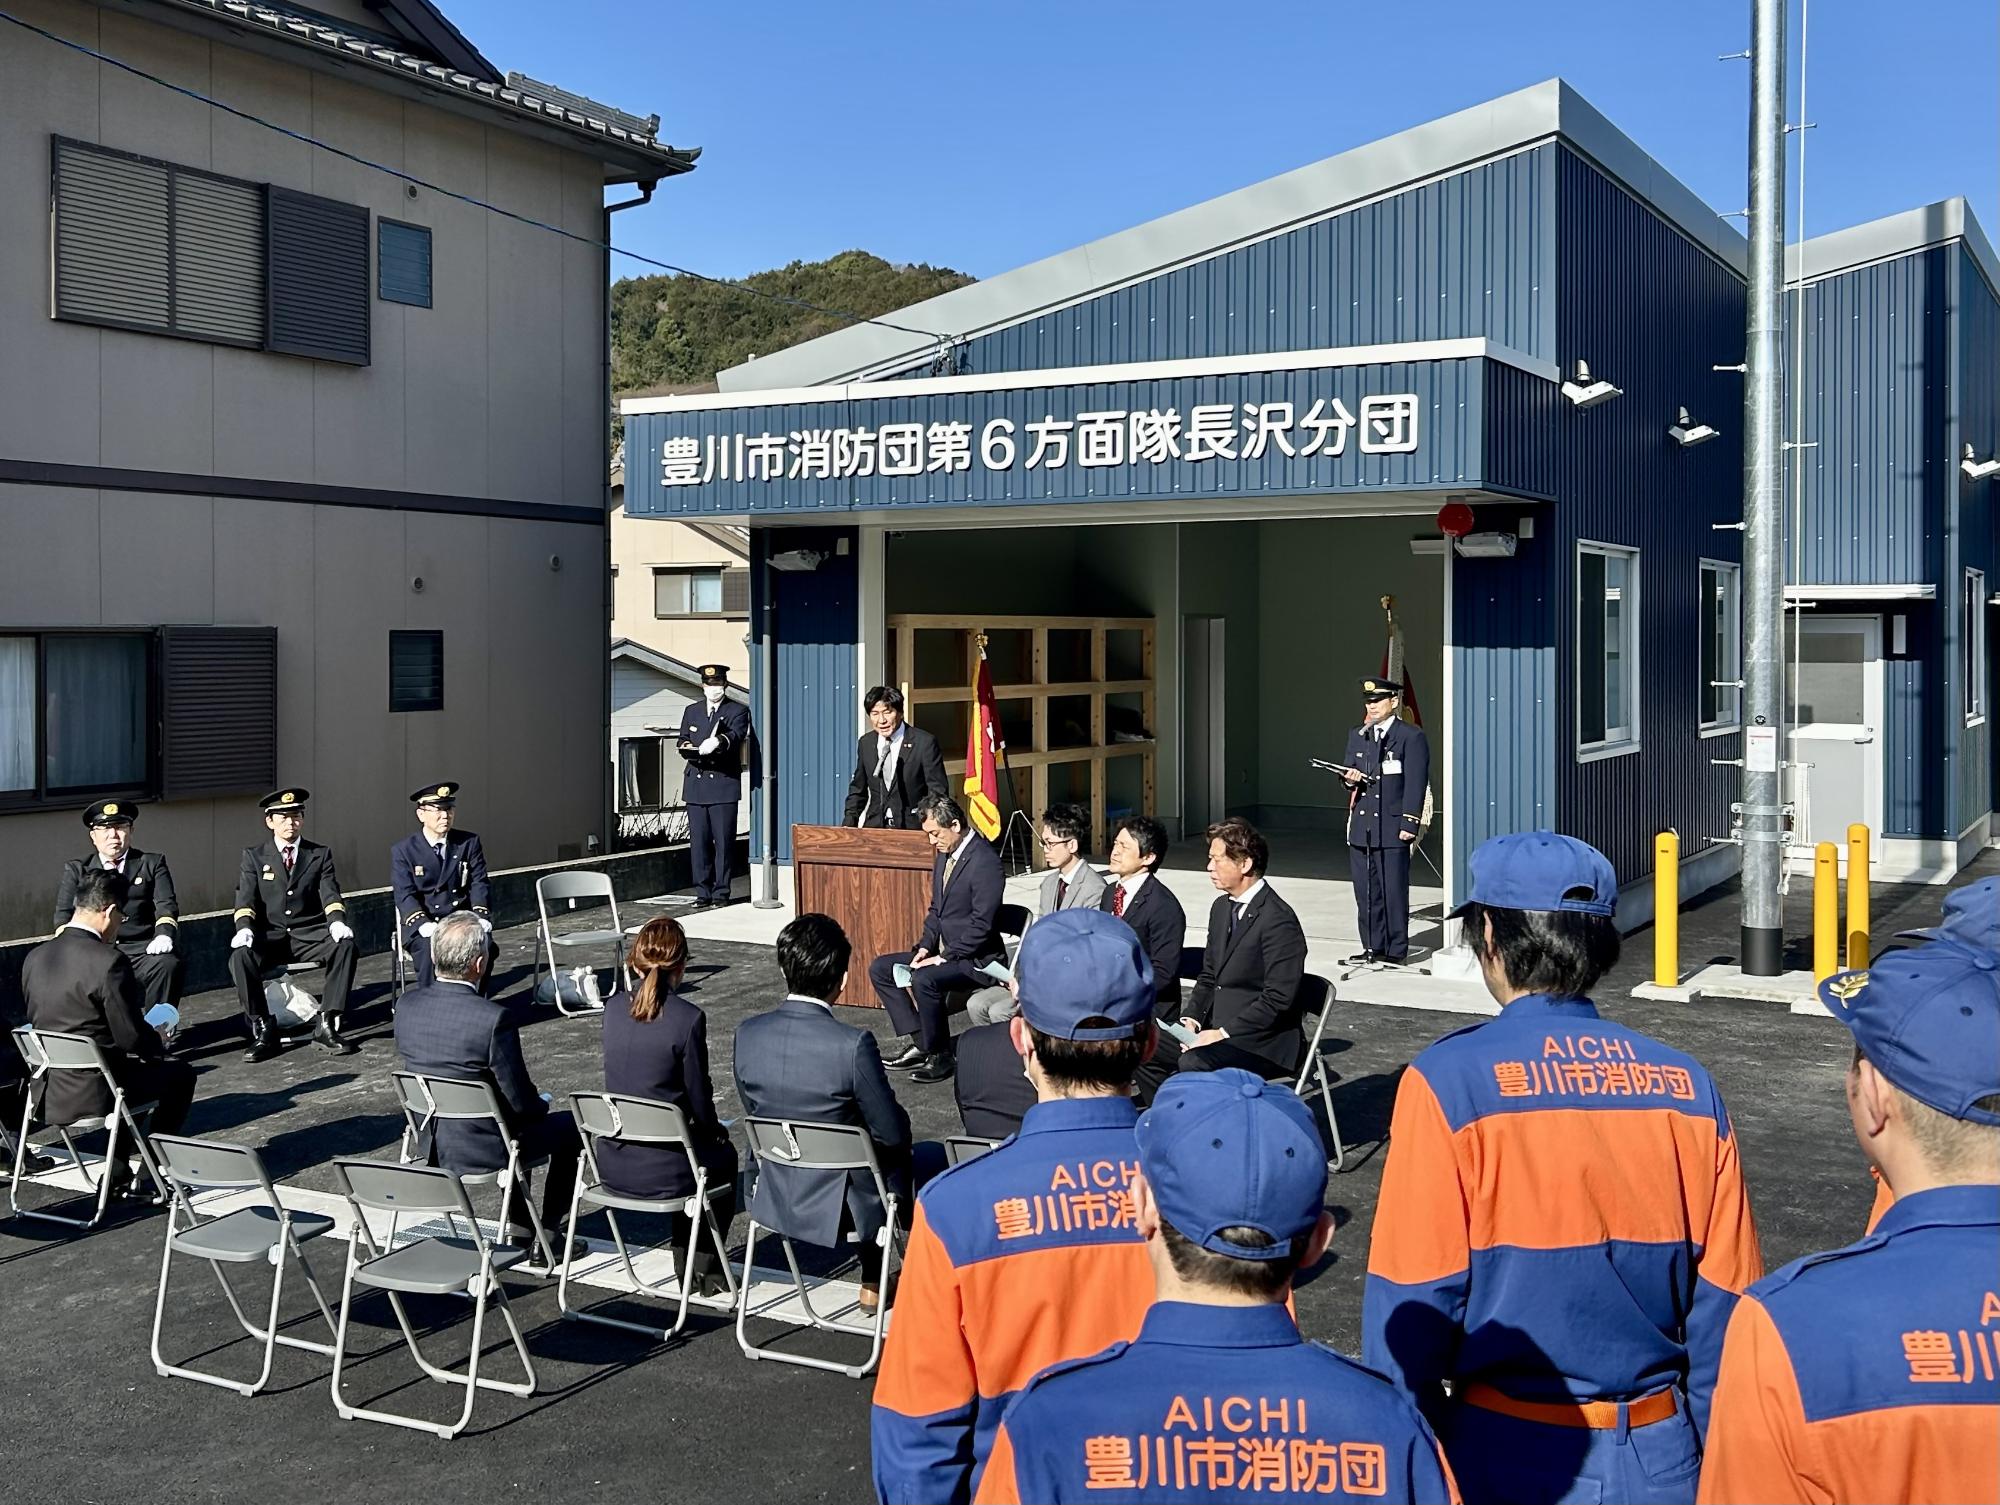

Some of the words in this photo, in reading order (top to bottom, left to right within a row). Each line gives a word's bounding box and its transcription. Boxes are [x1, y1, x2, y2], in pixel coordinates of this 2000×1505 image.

[660, 392, 1419, 487] 豊川市消防団第6方面隊長沢分団
[1543, 1035, 1637, 1061] AICHI
[1494, 1060, 1696, 1101] 豊川市消防団
[1163, 1396, 1307, 1434] AICHI
[1085, 1435, 1387, 1497] 豊川市消防団
